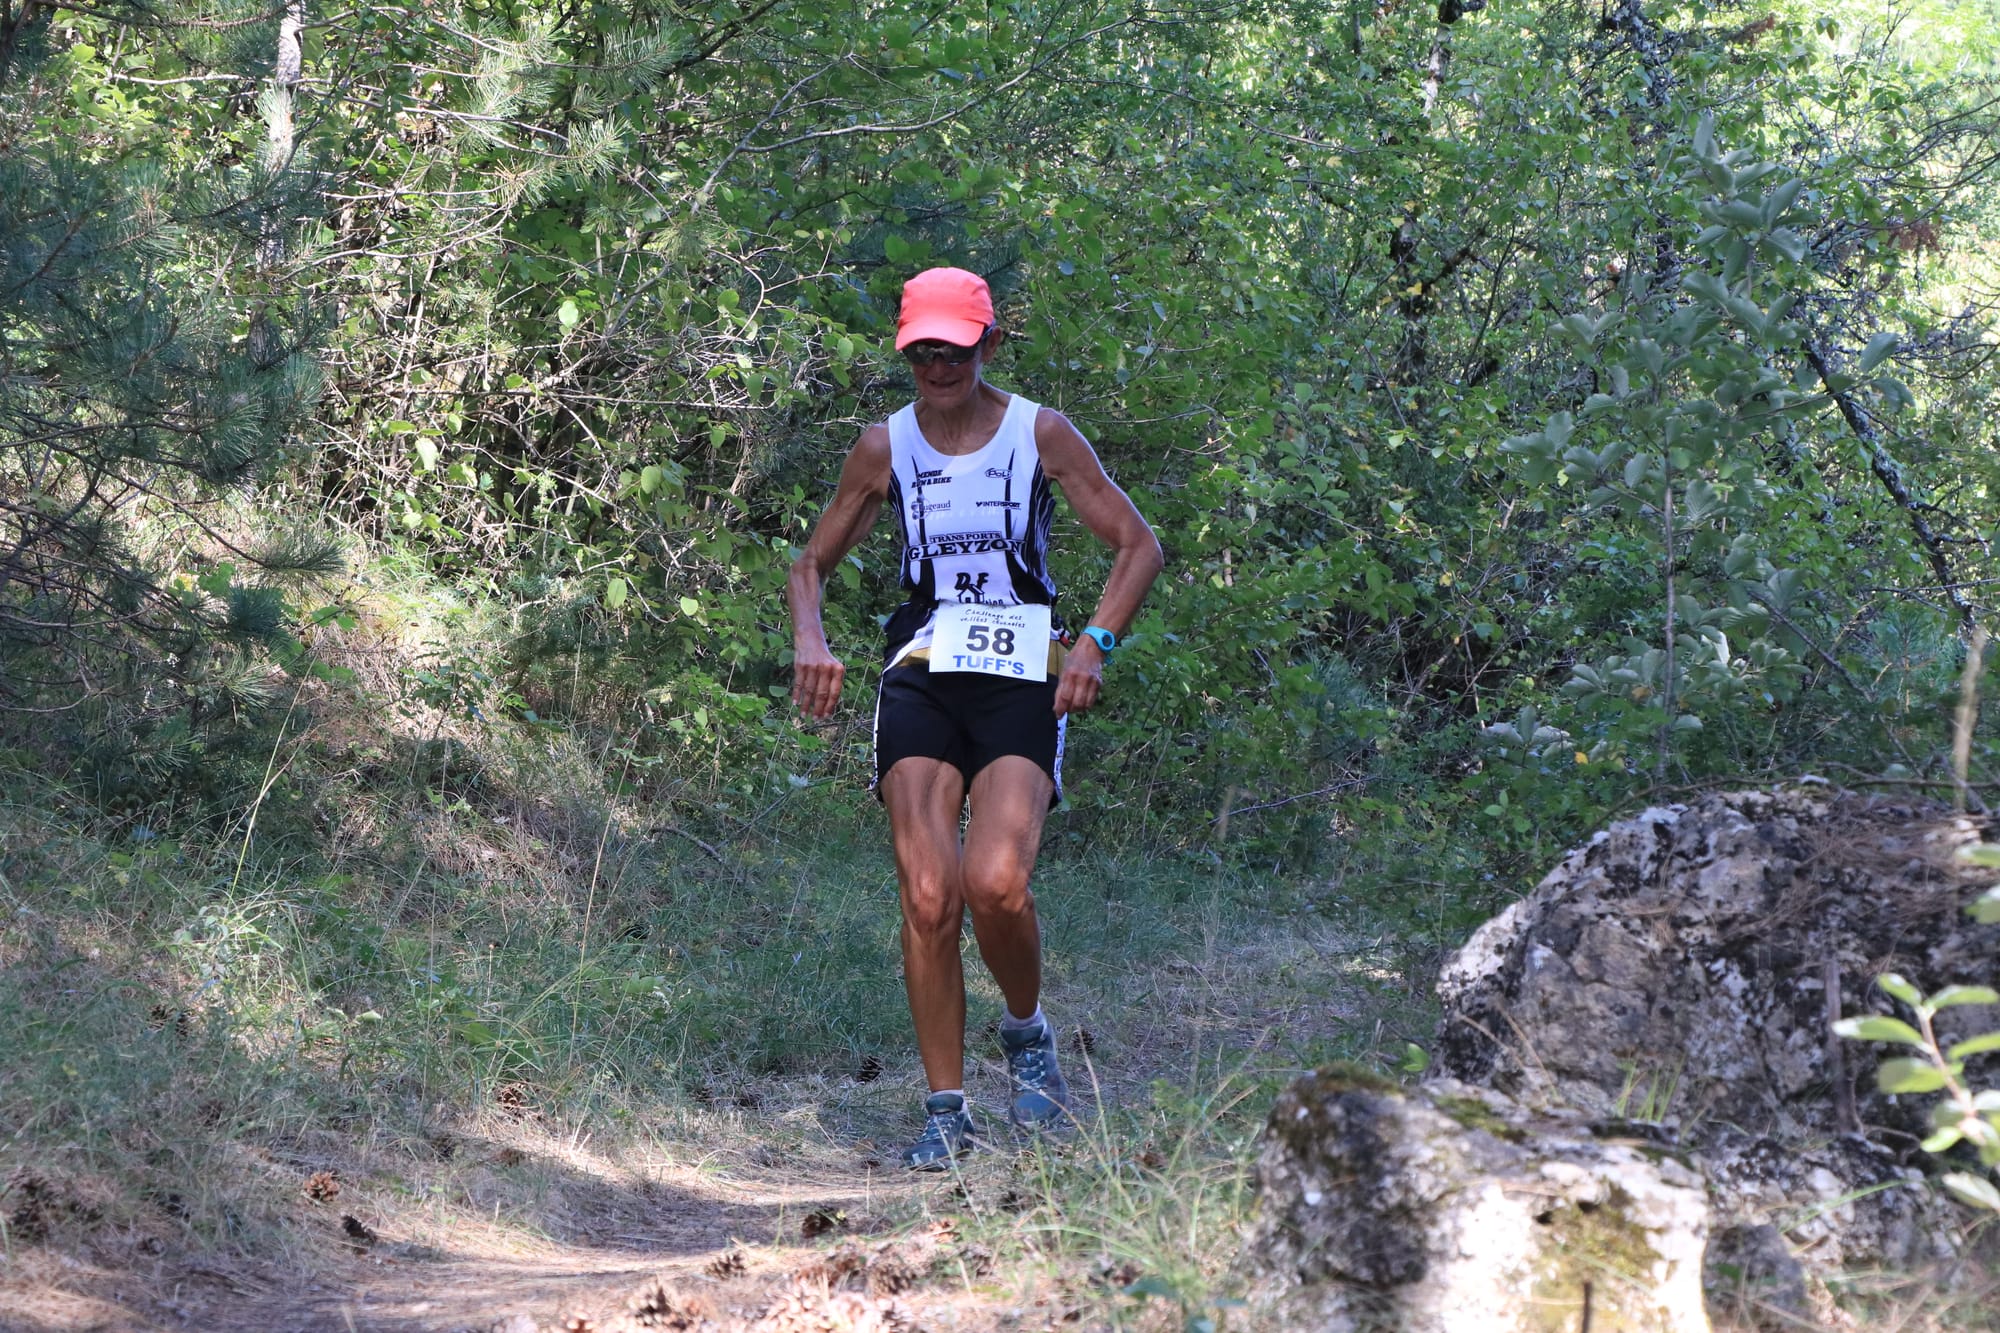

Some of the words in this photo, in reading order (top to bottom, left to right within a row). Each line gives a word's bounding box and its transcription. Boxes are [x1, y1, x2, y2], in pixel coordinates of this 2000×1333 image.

[908, 539, 1020, 560] GLEYZON
[966, 624, 1015, 656] 58
[952, 655, 1025, 675] TUFF'S
